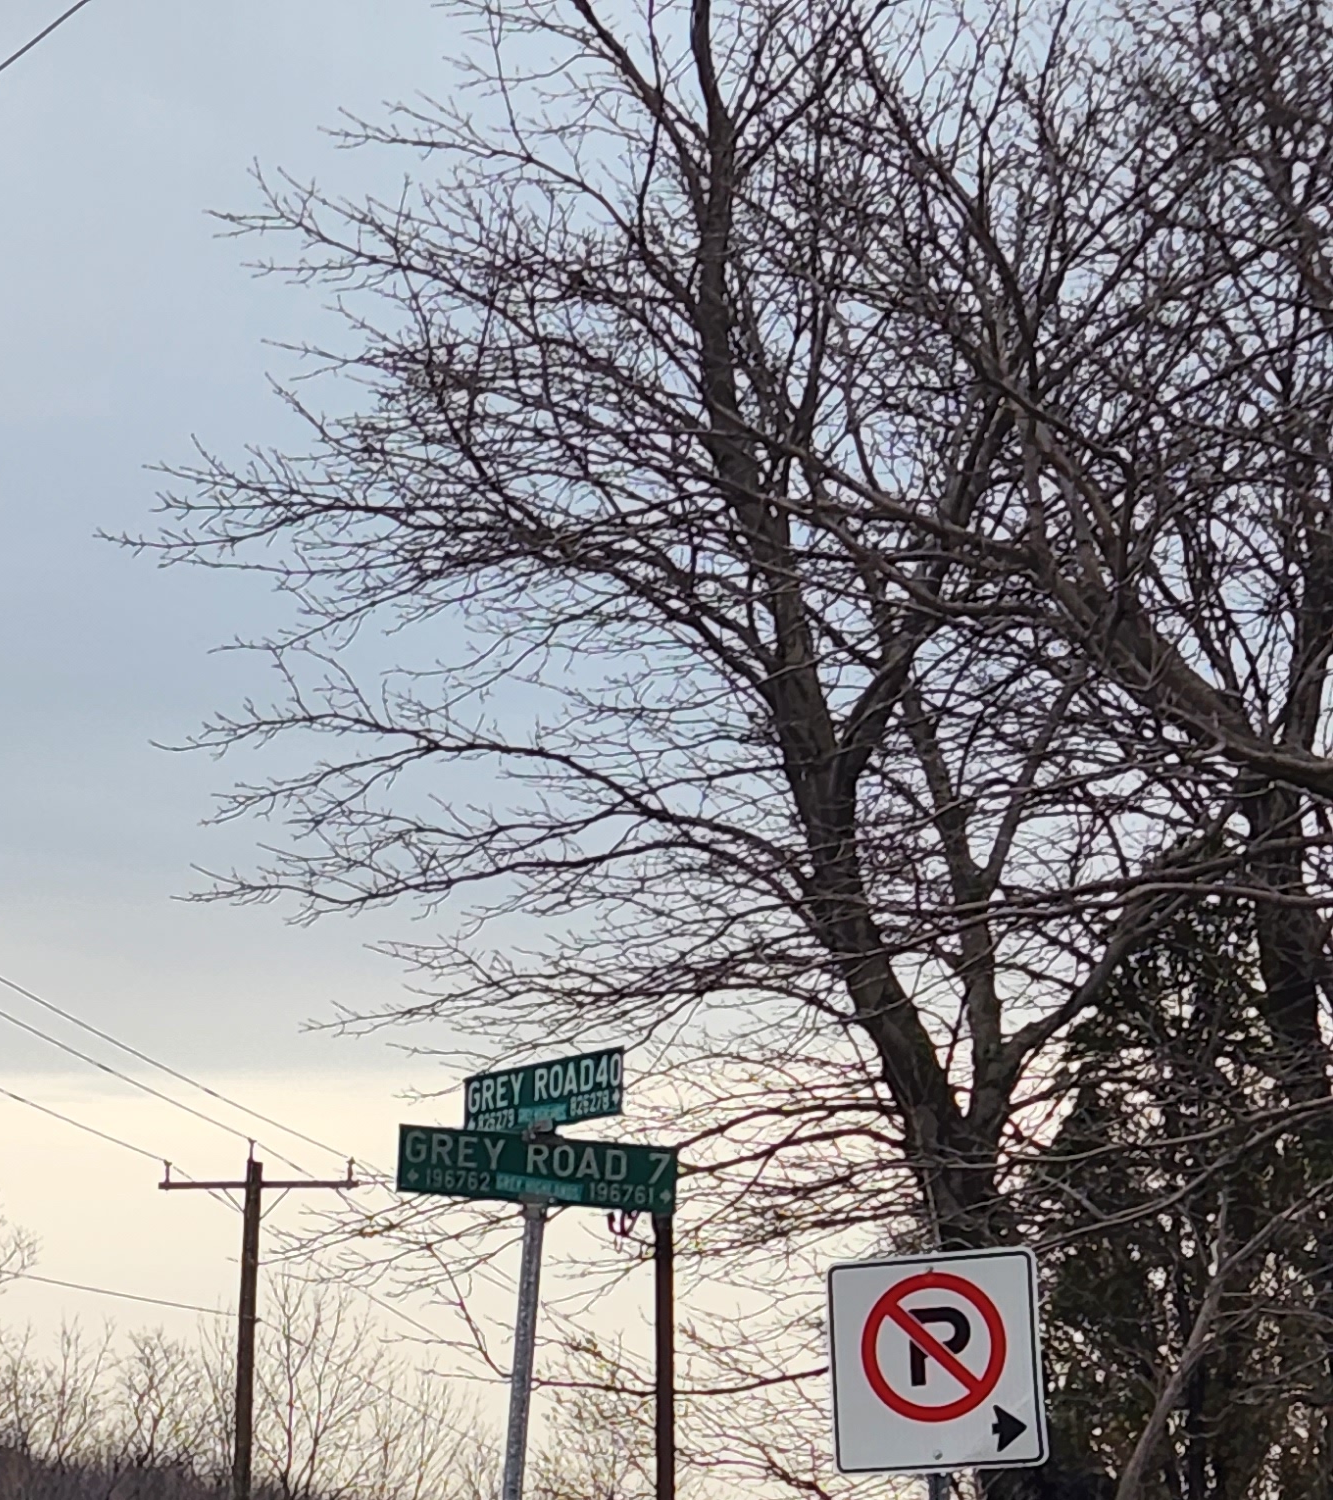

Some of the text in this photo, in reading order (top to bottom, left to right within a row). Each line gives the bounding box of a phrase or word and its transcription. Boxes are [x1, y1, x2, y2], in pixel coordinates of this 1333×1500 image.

[467, 1072, 525, 1114] GREY
[405, 1130, 671, 1185] GREY ROAD 7
[425, 1168, 491, 1191] 196762
[589, 1182, 654, 1205] 196761
[907, 1306, 971, 1387] P
